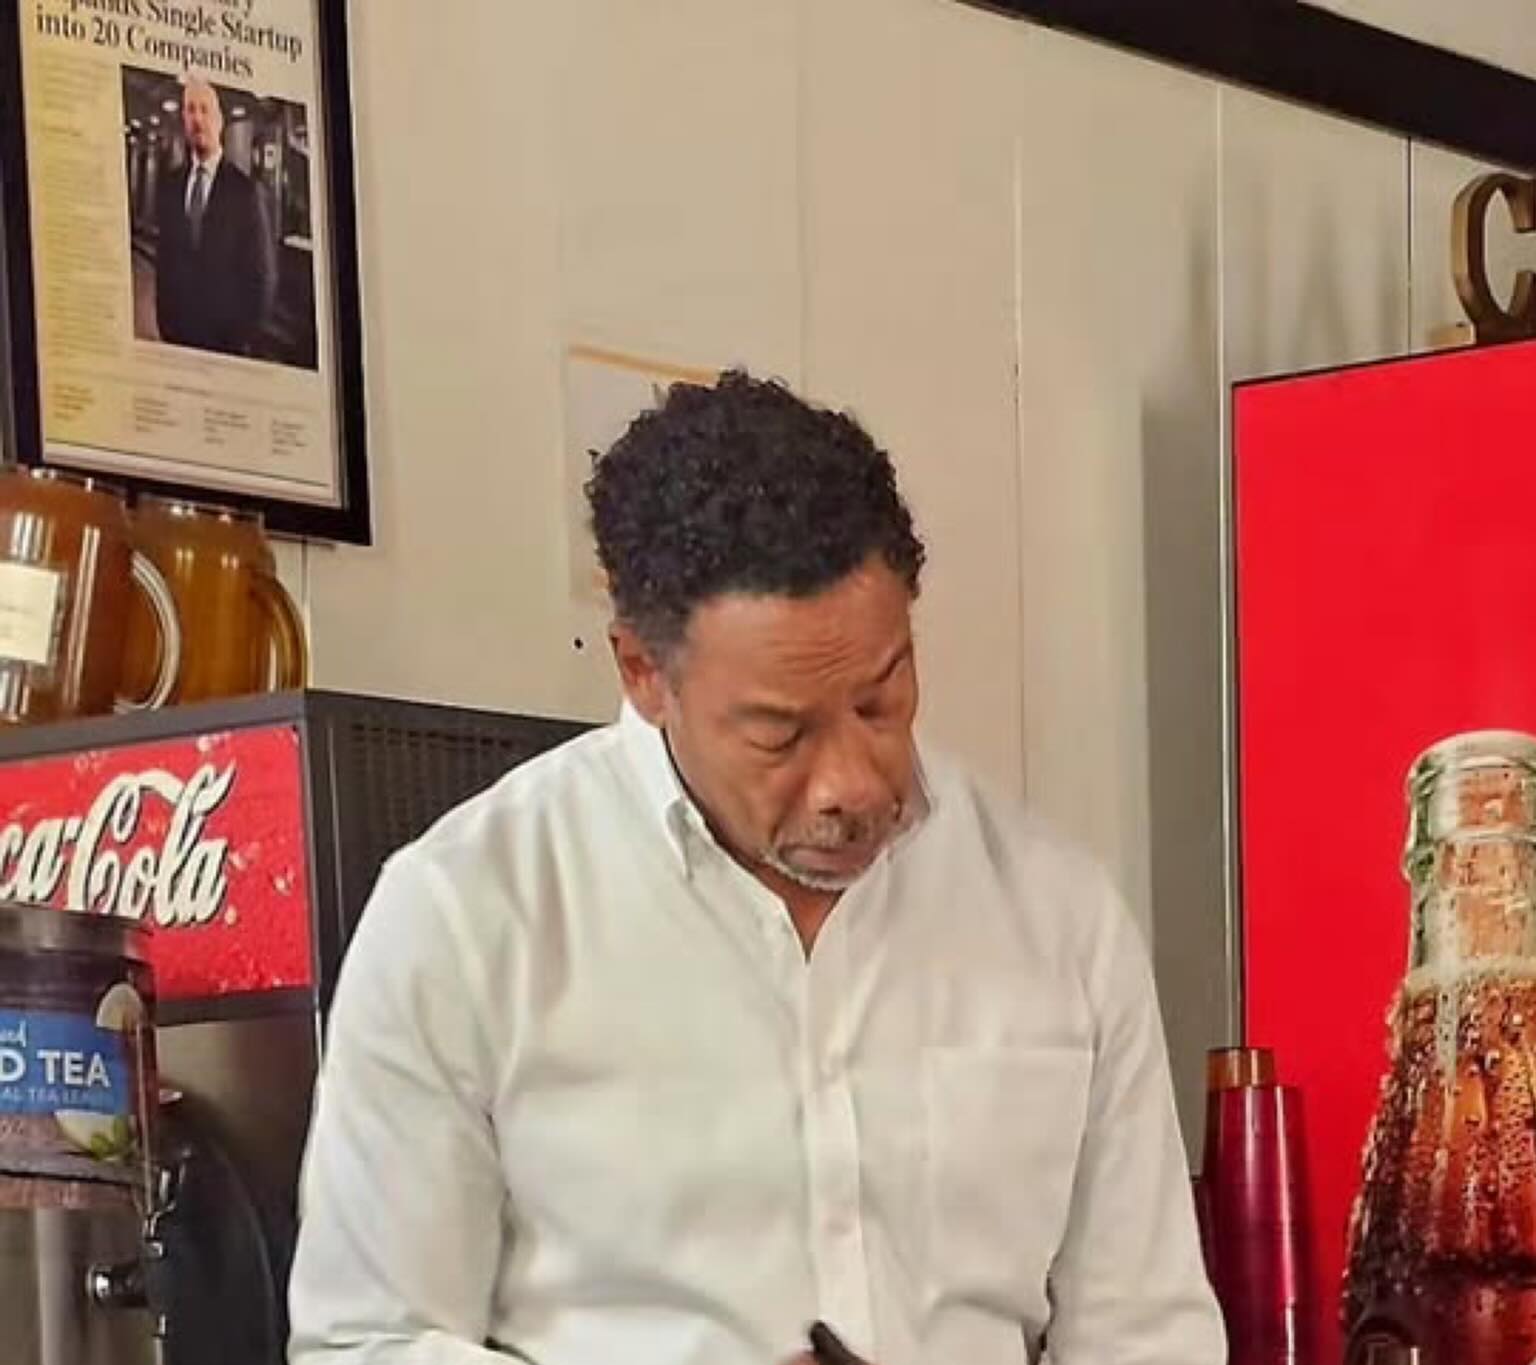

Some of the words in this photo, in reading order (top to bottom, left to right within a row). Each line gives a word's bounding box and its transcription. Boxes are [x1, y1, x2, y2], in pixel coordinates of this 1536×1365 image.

[36, 4, 86, 40] into
[92, 16, 120, 47] 20
[127, 24, 253, 78] Companies
[146, 0, 217, 37] Single
[221, 11, 303, 63] Startup
[0, 760, 237, 926] ca-Cola
[37, 1050, 112, 1088] TEA
